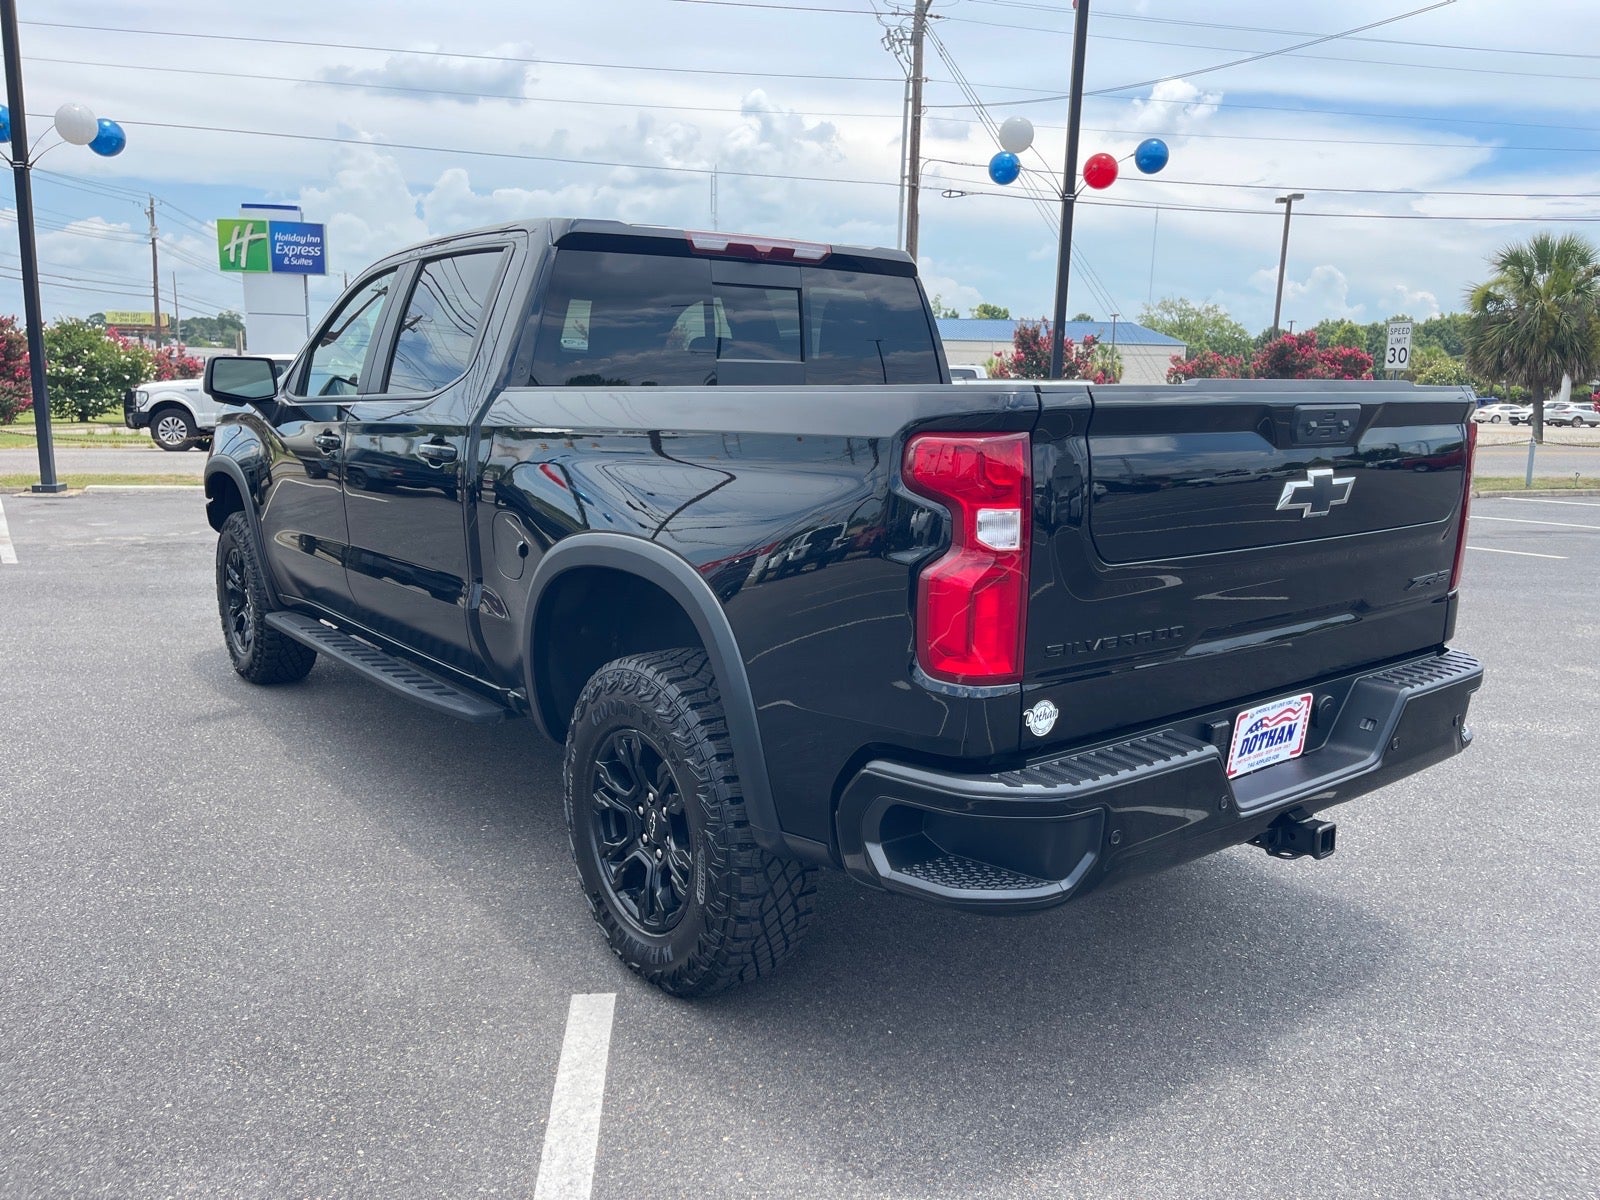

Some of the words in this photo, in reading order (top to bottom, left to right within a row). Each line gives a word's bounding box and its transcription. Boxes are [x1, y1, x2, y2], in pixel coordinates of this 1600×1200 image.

[275, 232, 306, 244] Holiday
[307, 234, 320, 243] Inn
[276, 242, 321, 256] Express
[284, 257, 290, 265] &
[290, 257, 313, 266] Suites
[1390, 327, 1411, 335] SPEED
[1390, 337, 1407, 345] LIMIT
[1387, 347, 1408, 364] 30
[1045, 625, 1185, 658] SILVERADO
[1024, 708, 1058, 727] Dothan
[1238, 723, 1298, 758] DOTHAN
